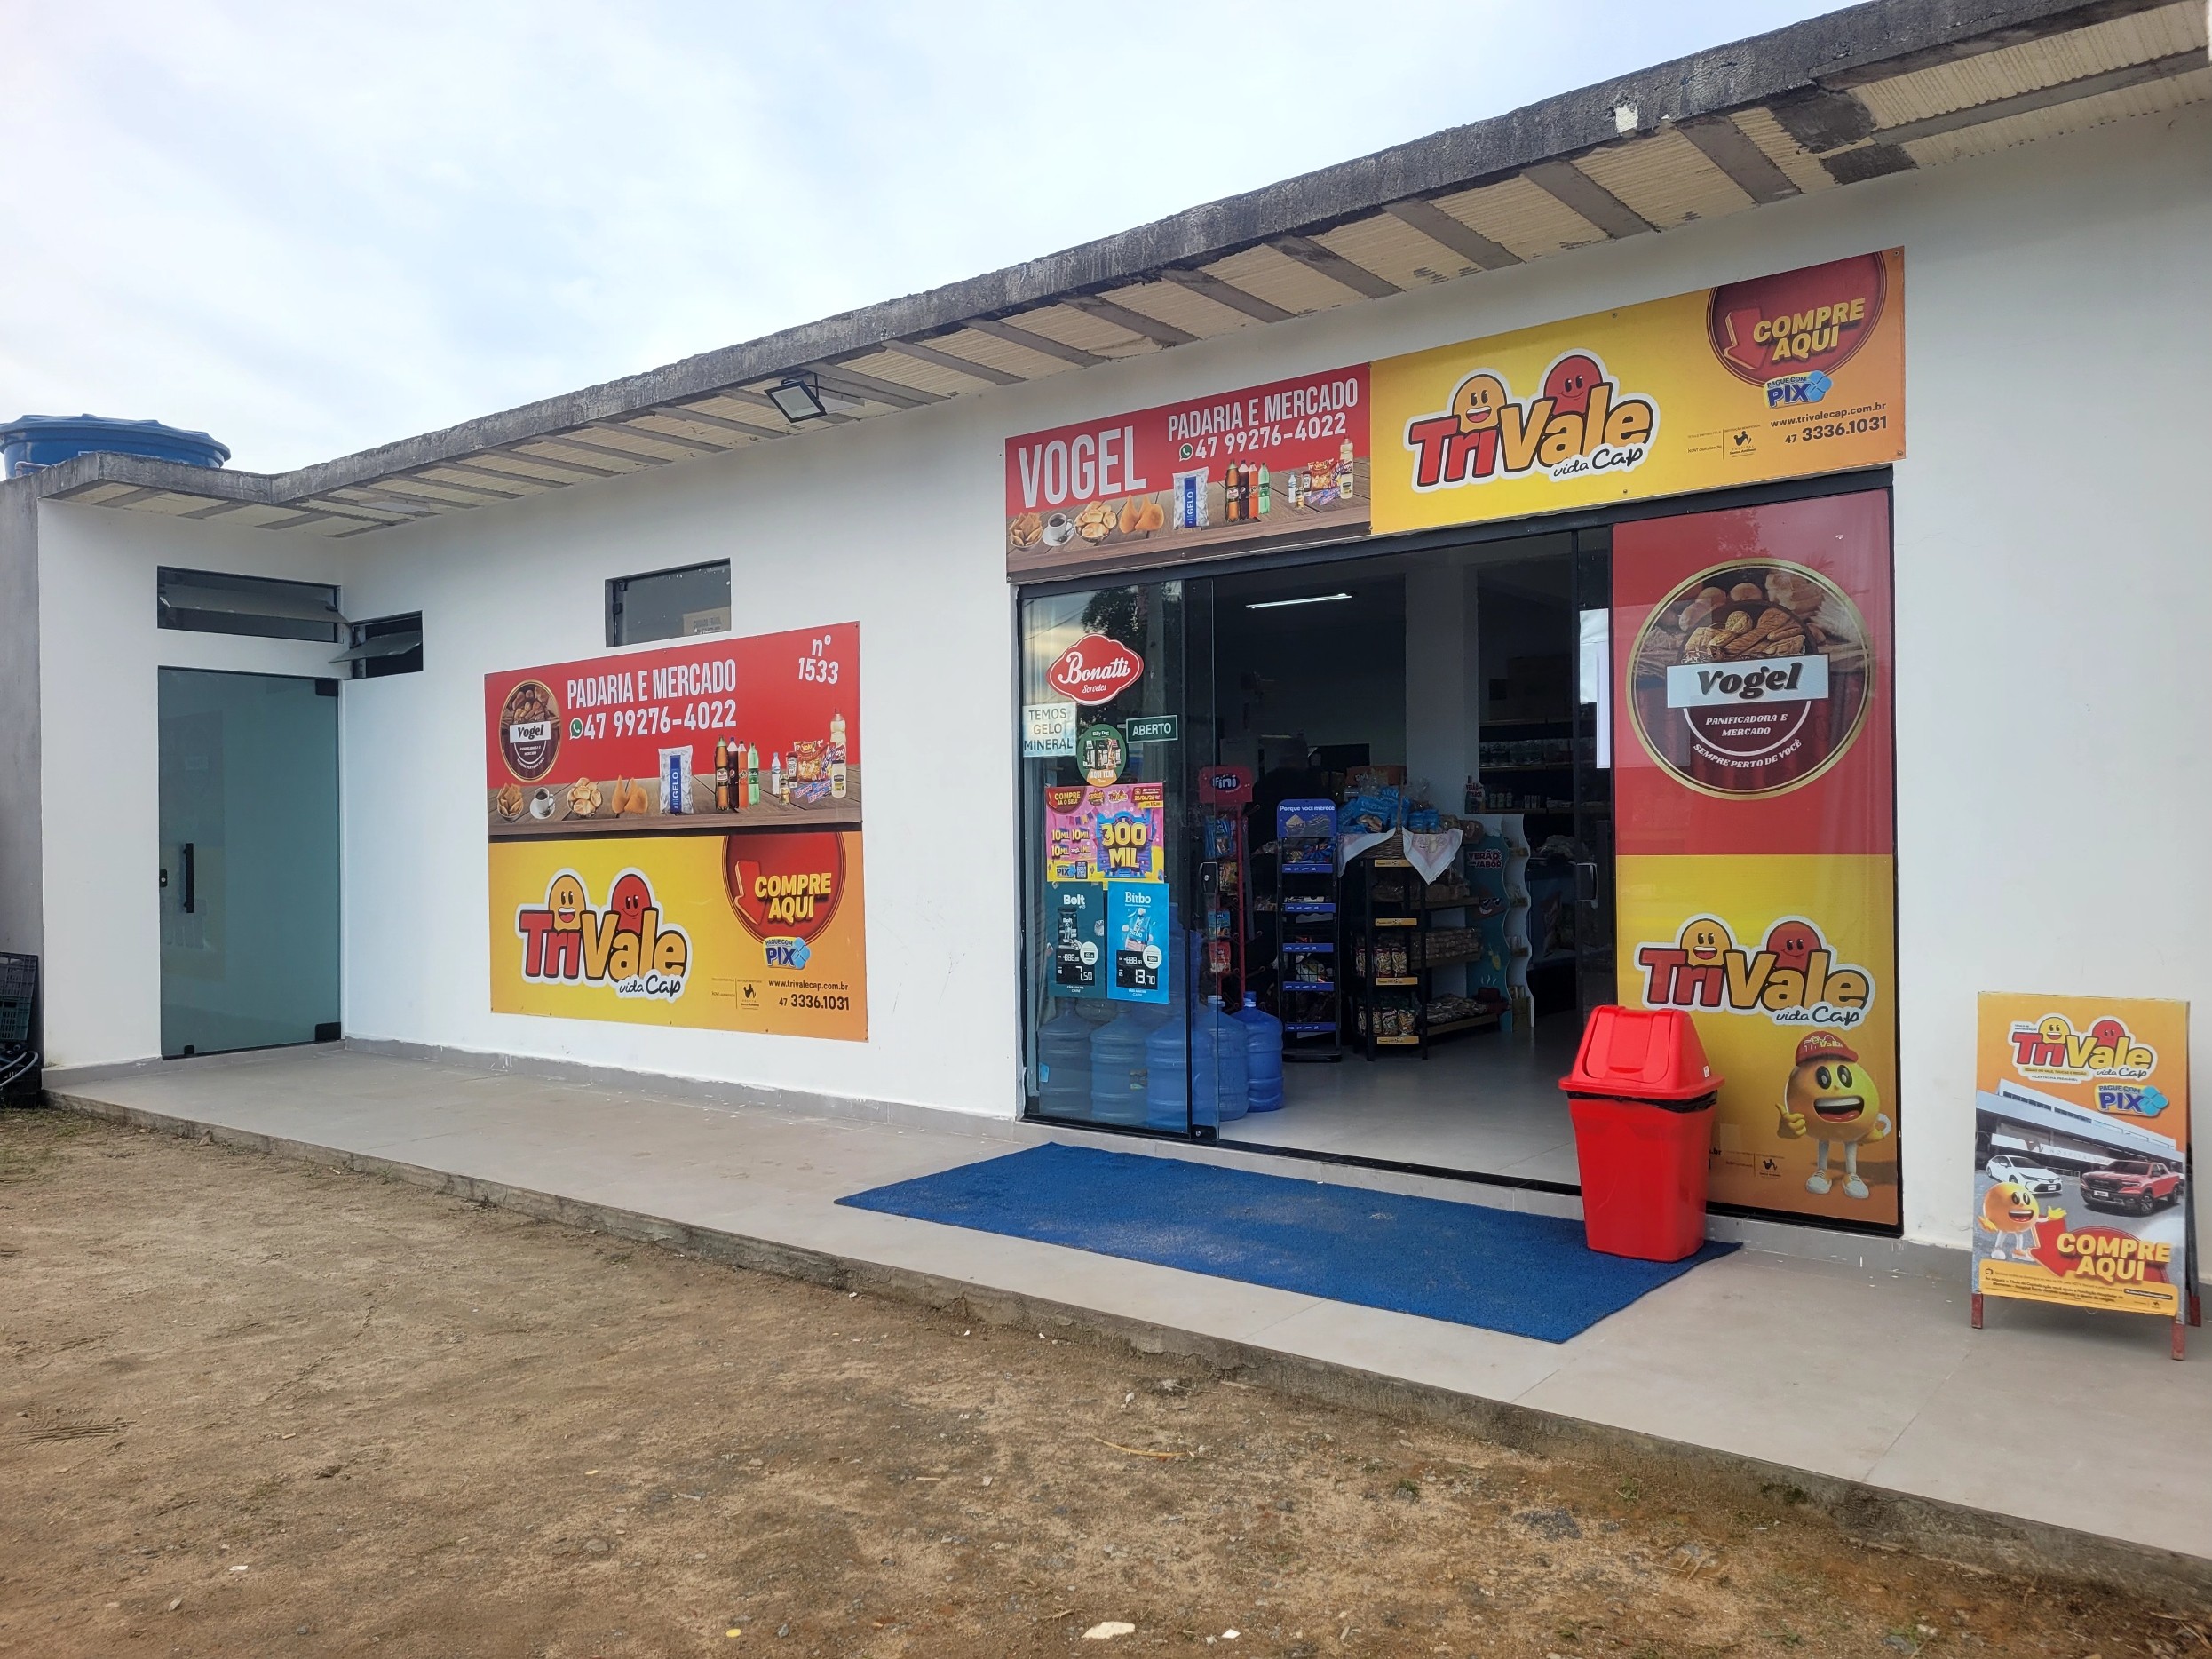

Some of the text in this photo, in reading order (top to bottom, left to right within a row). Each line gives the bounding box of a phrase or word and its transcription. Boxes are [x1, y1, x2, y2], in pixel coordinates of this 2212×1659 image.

[1753, 297, 1866, 343] COMPRE
[1772, 325, 1839, 361] AQUI
[1767, 377, 1790, 388] PAGUE
[1768, 383, 1811, 407] PIX
[1168, 377, 1358, 441] PADARIA E MERCADO
[1771, 402, 1887, 428] www.trivalecap.com.br
[1195, 413, 1346, 458] 47 99276-4022
[1408, 382, 1653, 487] TriVale
[1785, 416, 1887, 444] 47 3336.1031
[1019, 425, 1147, 509] VOGEL
[1553, 448, 1643, 477] vida Cap
[798, 657, 839, 685] 1533
[1058, 651, 1131, 684] Bonatti
[567, 658, 736, 710] PADARIA E MERCADO
[1082, 684, 1107, 694] Sorvetes
[1697, 662, 1804, 700] Vogel
[583, 699, 736, 740] 47 99276-4022
[1028, 708, 1067, 721] TEMOS
[1705, 713, 1788, 726] PANIFICADORA E
[518, 724, 544, 740] Vogel
[1034, 723, 1062, 735] GELO
[1132, 723, 1172, 736] ABERTO
[1721, 726, 1771, 737] MERCADO
[1024, 738, 1073, 751] MINERAL
[1693, 738, 1803, 768] SEMPRE PERTO DE VOCÊ
[1214, 775, 1237, 788] Fini
[1054, 791, 1081, 800] COMPRE
[1101, 822, 1146, 846] 300
[1109, 847, 1139, 869] MIL
[755, 873, 832, 898] COMPRE
[767, 896, 814, 921] AQUI
[1064, 894, 1085, 905] Bolt
[1125, 892, 1151, 904] Birbo
[519, 907, 688, 980] TriVale
[765, 947, 796, 966] PIX
[619, 974, 681, 998] vida Cap
[769, 980, 848, 992] www.trivalecap.com.br
[1639, 947, 1869, 1012] TriVale
[779, 993, 850, 1011] 47 3336.1031
[1776, 1006, 1860, 1027] vida Cap
[2012, 1032, 2153, 1070] TriVale
[2118, 1067, 2147, 1078] Cap
[2099, 1092, 2145, 1113] PIX
[2057, 1232, 2171, 1264] COMPRE
[2075, 1256, 2145, 1283] AQUI
